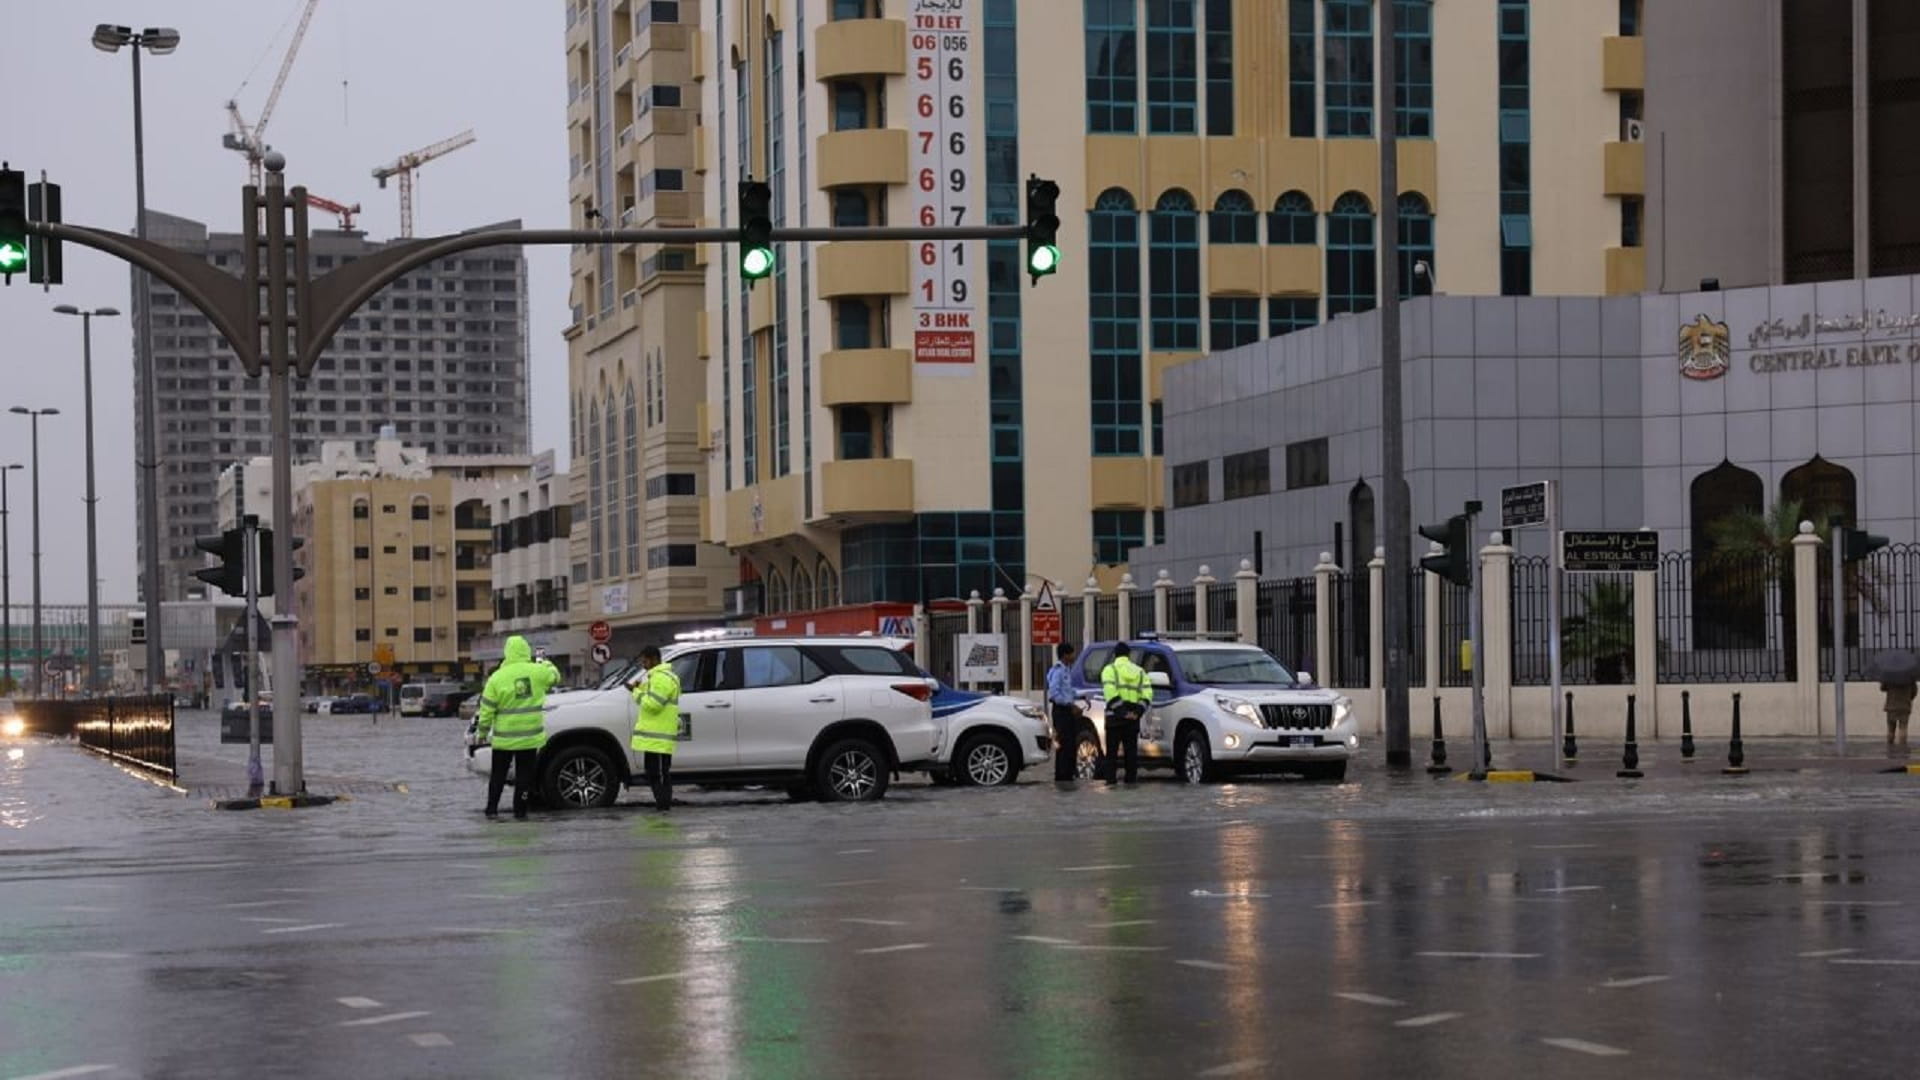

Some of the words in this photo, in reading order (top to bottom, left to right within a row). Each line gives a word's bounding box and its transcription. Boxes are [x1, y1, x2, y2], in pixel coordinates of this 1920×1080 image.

[914, 14, 934, 28] TO
[938, 15, 963, 29] LET
[912, 34, 936, 50] 06
[943, 35, 968, 51] 056
[919, 312, 930, 328] 3
[934, 312, 970, 328] BHK
[1749, 348, 1841, 375] CENTRAL
[1846, 342, 1902, 368] BANK
[1907, 342, 1920, 363] O
[1622, 534, 1657, 550] شارع
[1566, 551, 1580, 560] AL
